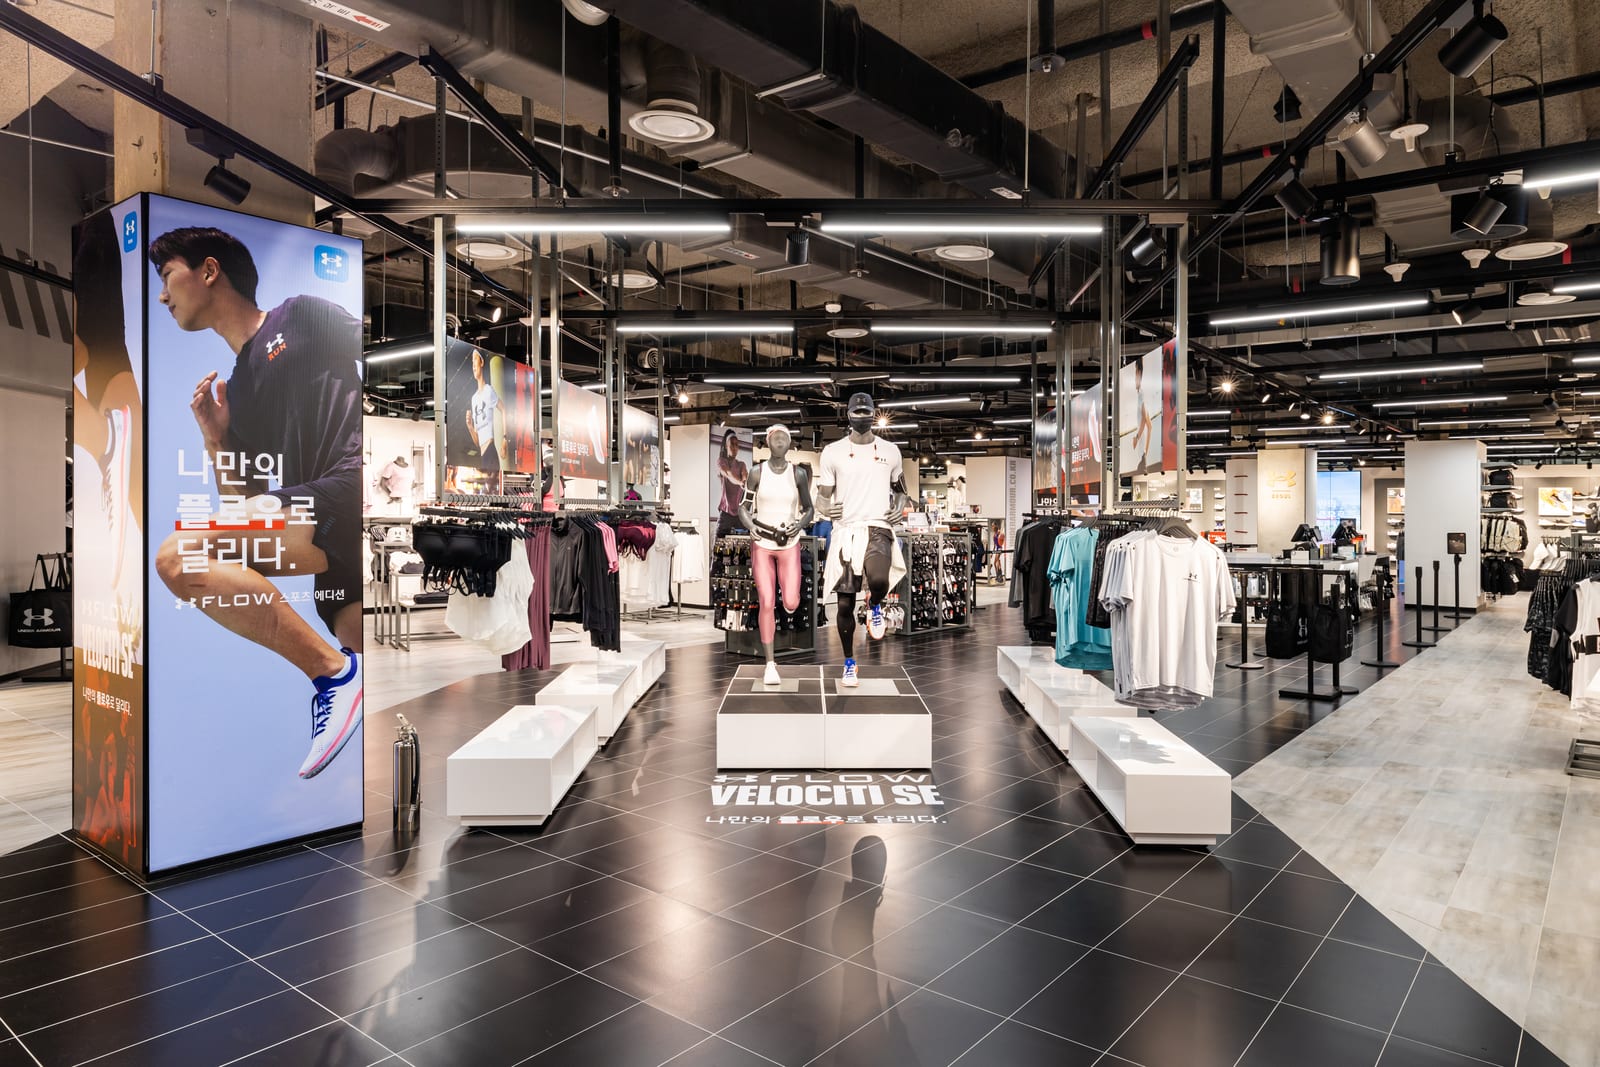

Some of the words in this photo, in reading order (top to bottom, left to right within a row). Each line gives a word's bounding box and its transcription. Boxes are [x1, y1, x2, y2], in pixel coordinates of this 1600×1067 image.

[268, 342, 286, 361] RUN
[177, 449, 283, 486] 나만의
[176, 493, 318, 530] 플로우로
[177, 537, 297, 574] 달리다.
[202, 592, 275, 609] FLOW
[279, 591, 312, 603] 스포츠
[314, 589, 345, 601] 에디션
[82, 624, 119, 676] VELOCITI
[121, 631, 134, 680] SE
[82, 686, 96, 703] 나만의
[96, 690, 115, 709] 플로우로
[770, 774, 929, 784] FLOW
[710, 784, 885, 806] VELOCITI
[891, 784, 945, 806] SE
[705, 815, 770, 824] 나만의
[779, 815, 867, 824] 플로우로
[873, 815, 947, 824] 달리다.
